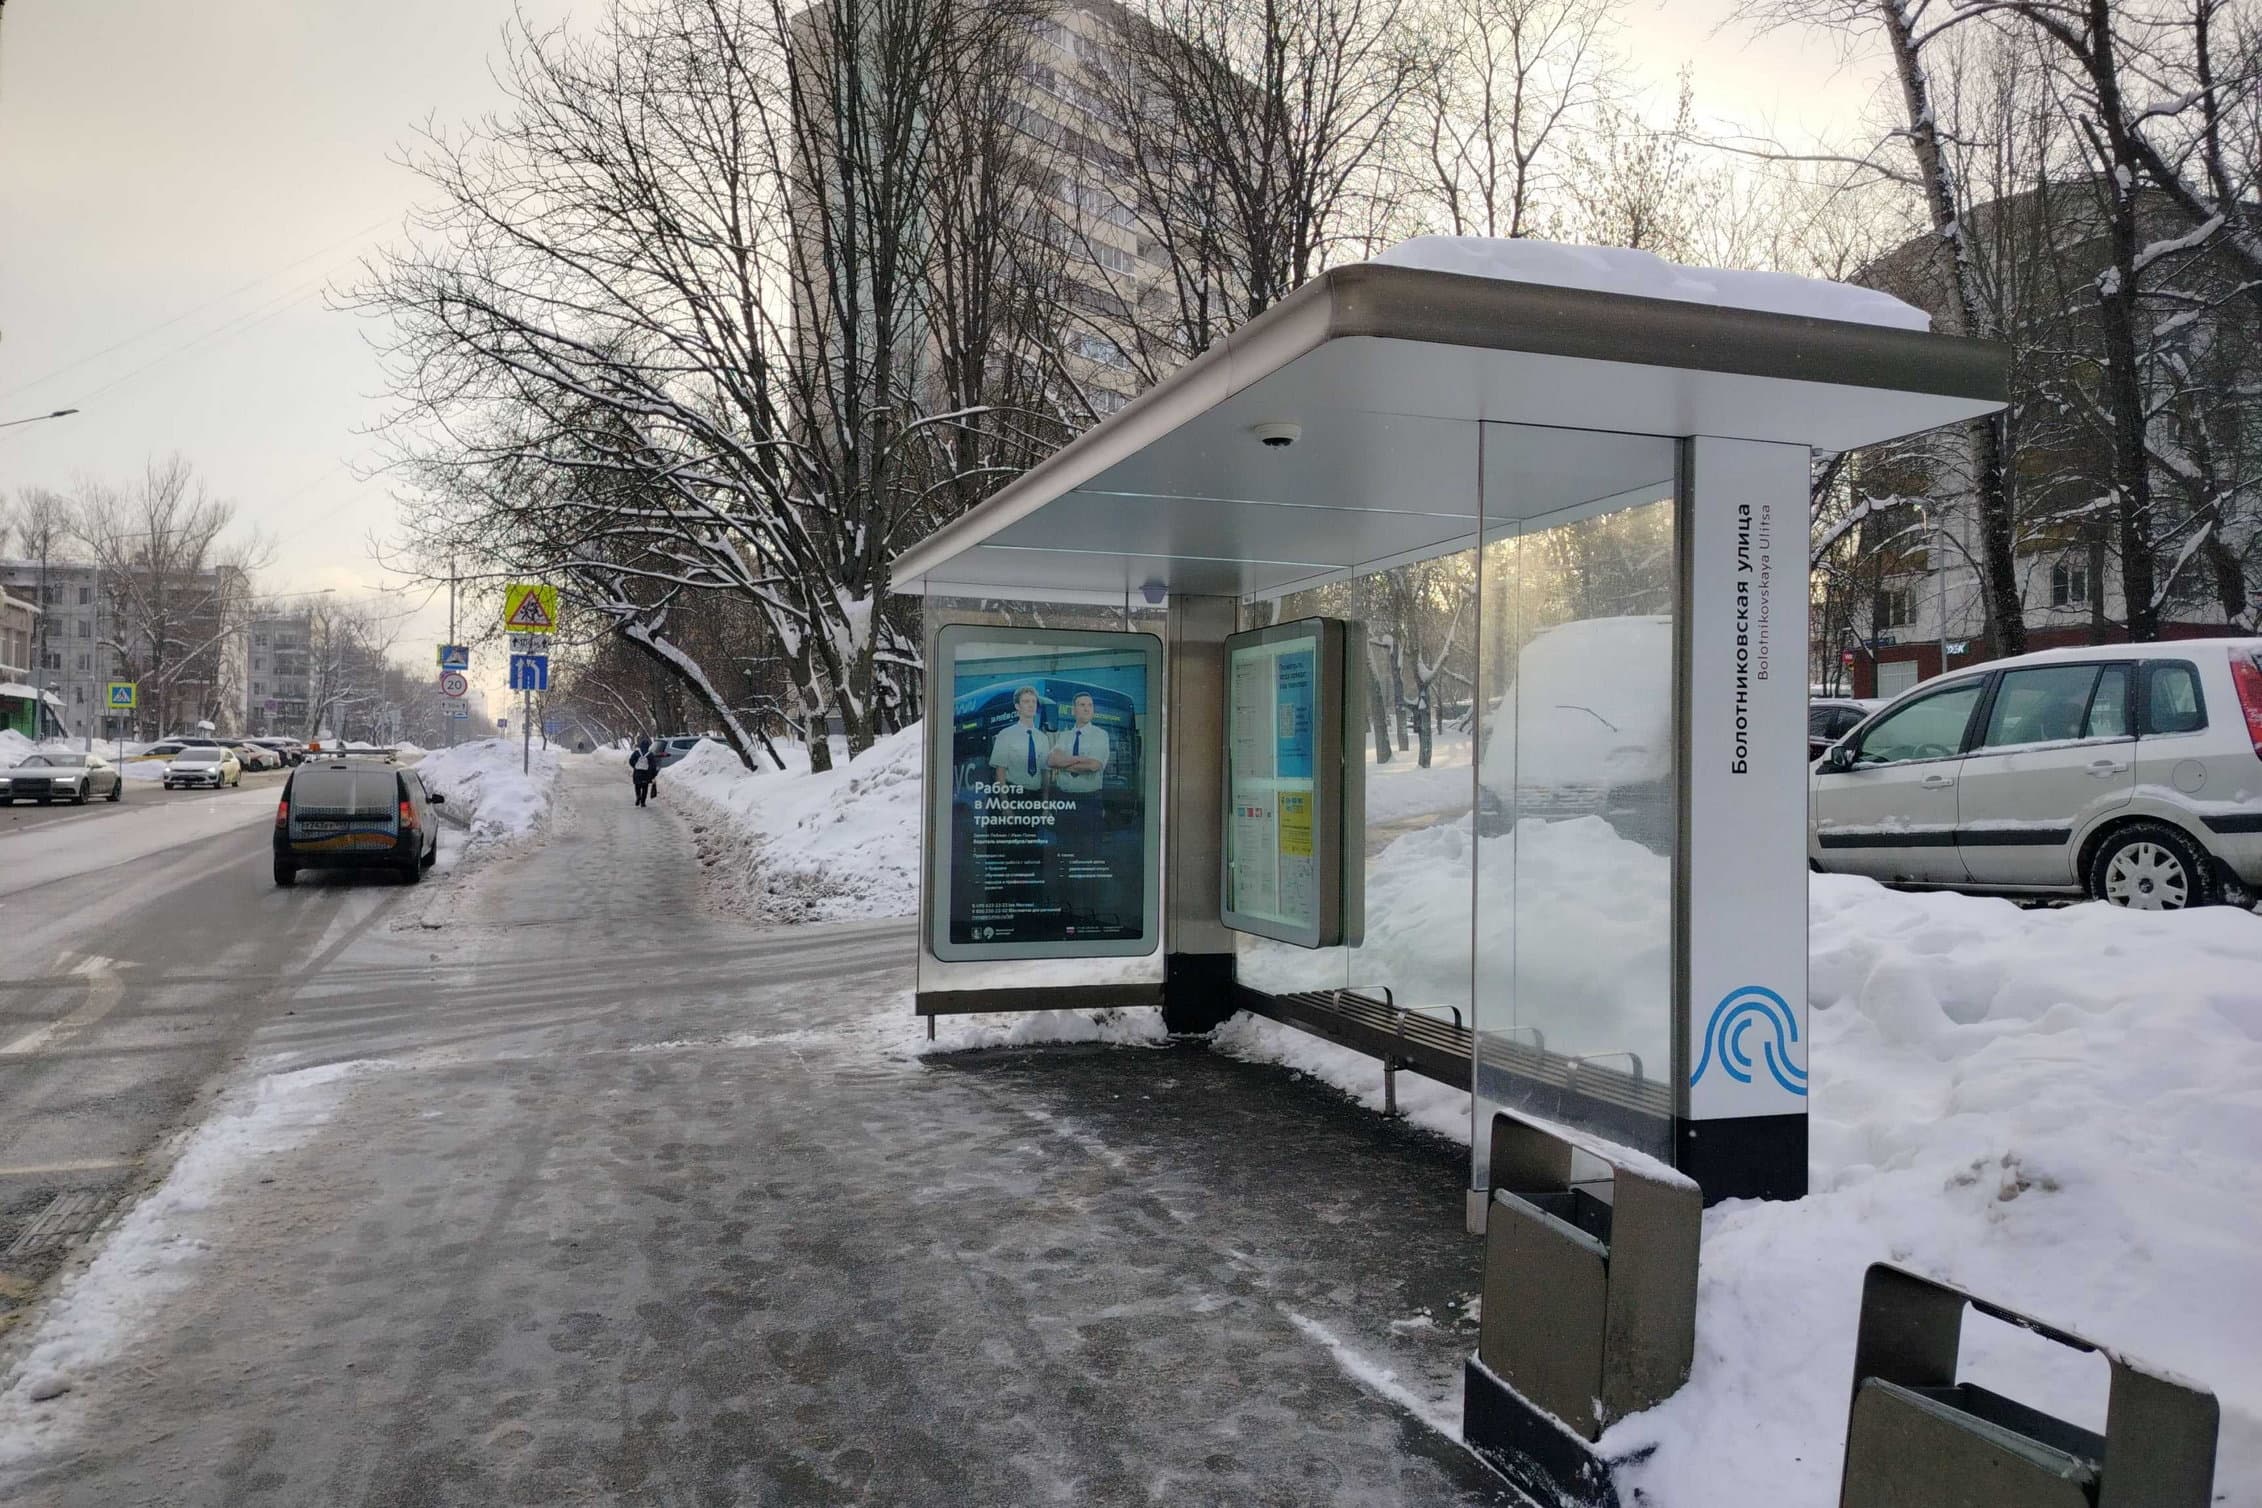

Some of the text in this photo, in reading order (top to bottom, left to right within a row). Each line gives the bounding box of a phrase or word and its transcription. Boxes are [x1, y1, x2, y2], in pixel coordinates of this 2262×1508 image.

[1758, 504, 1773, 681] Bolotnikovskaya Ulitsa
[1732, 504, 1752, 774] Болотниковская улица
[447, 680, 462, 690] 20
[975, 781, 1024, 795] Работа
[975, 797, 1077, 811] в Московском
[974, 814, 1056, 828] транспорте
